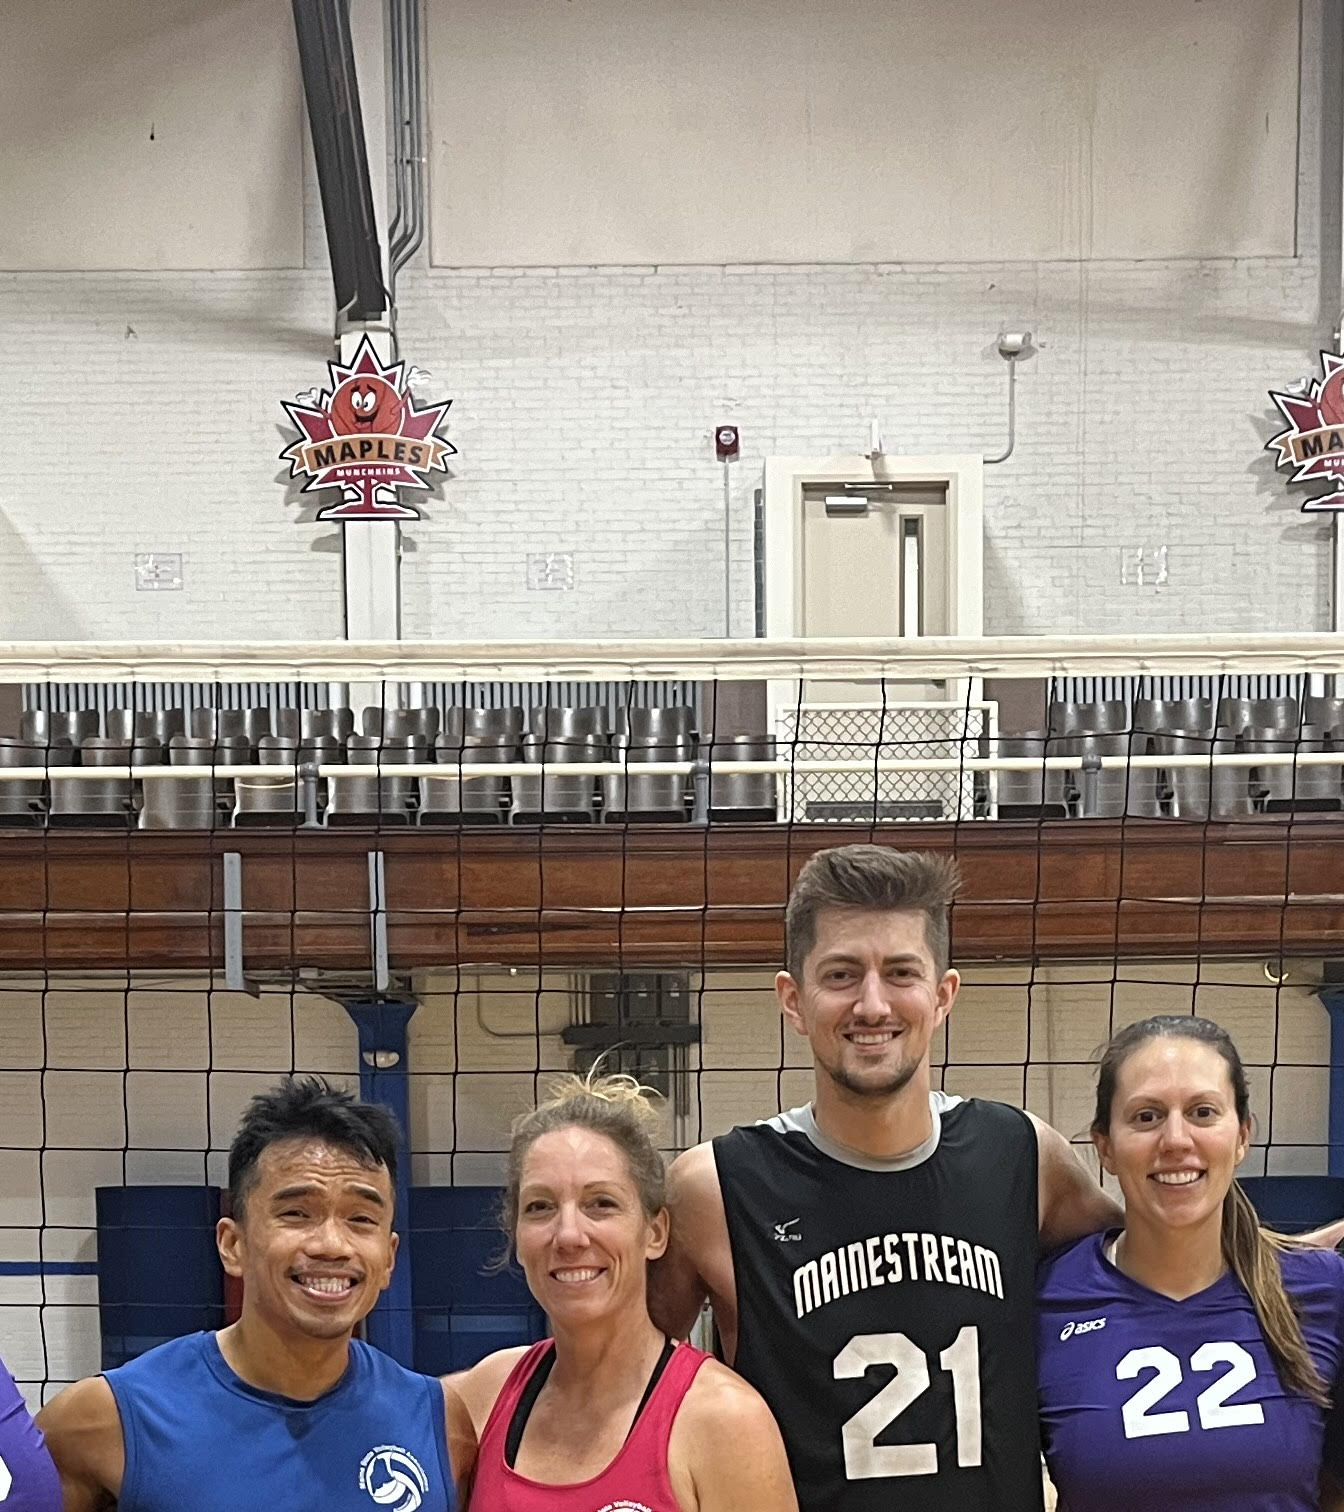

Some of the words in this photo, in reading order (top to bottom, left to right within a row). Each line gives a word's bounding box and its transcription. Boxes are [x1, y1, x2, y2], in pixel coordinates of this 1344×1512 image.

[313, 439, 423, 467] MAPLES
[336, 467, 401, 477] MUNCHKINS
[793, 1232, 1004, 1319] MAINESTREAM
[833, 1325, 982, 1480] 21
[1115, 1340, 1265, 1439] 22
